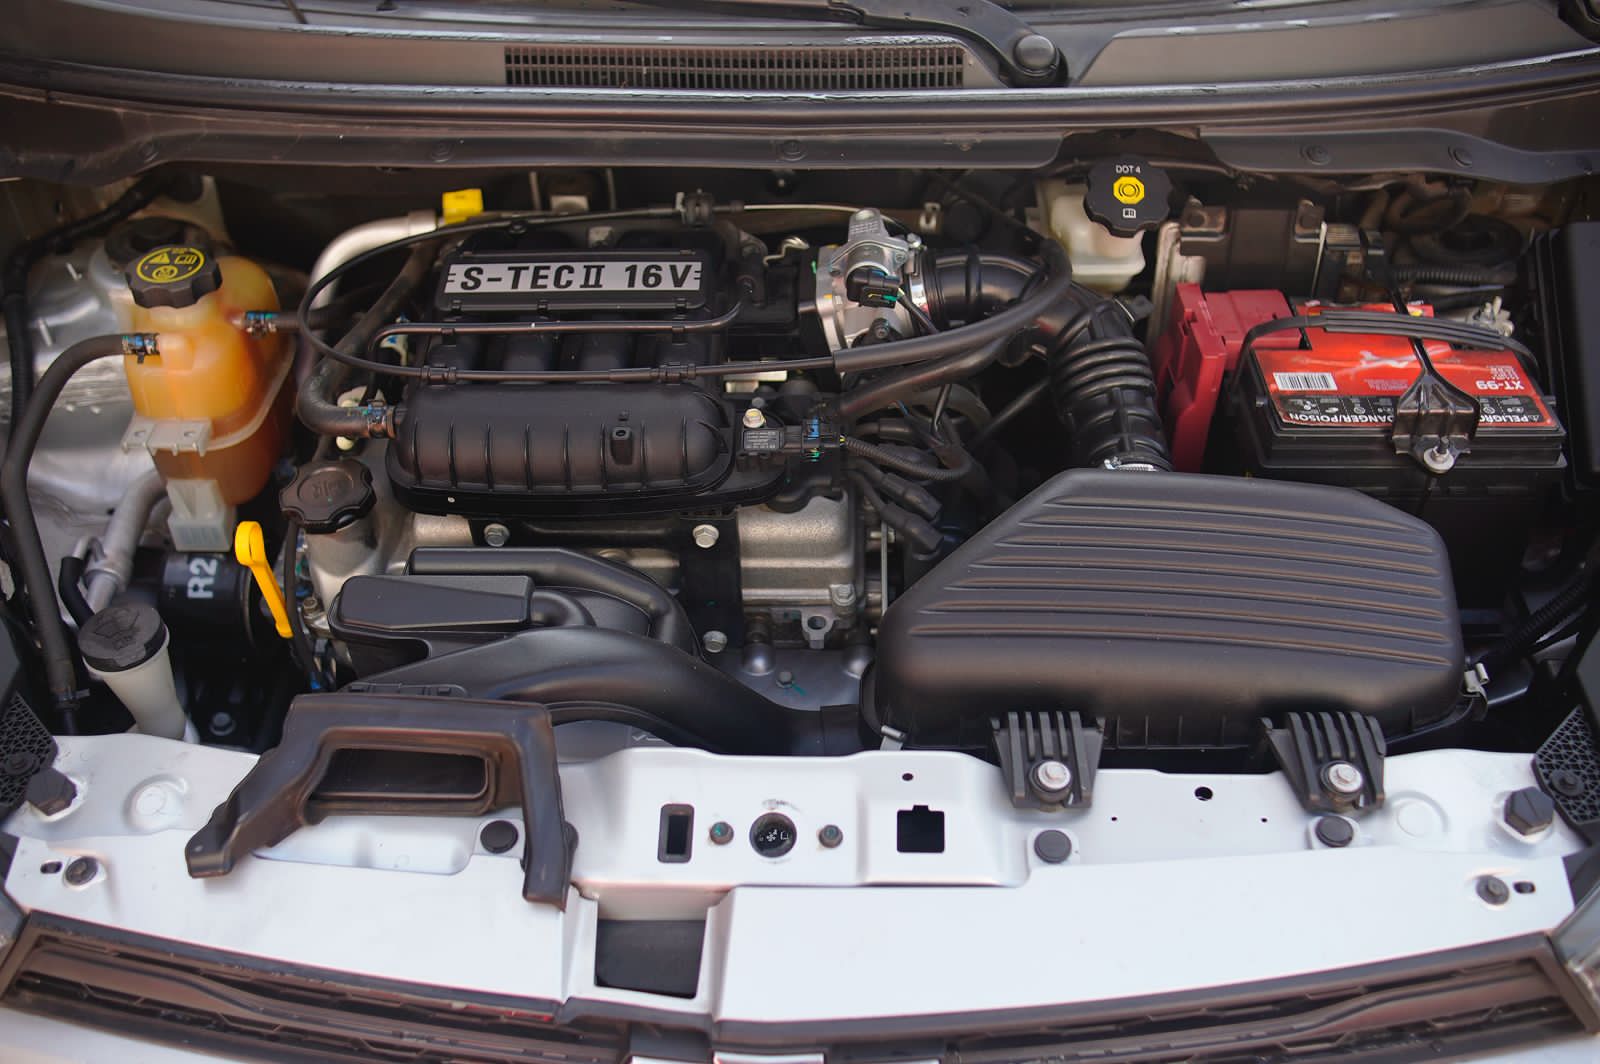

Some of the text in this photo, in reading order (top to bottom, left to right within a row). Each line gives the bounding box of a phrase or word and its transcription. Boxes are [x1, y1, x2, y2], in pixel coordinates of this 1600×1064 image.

[1115, 165, 1142, 174] DOT 4
[625, 264, 693, 289] 16V
[1475, 380, 1525, 390] XT-99
[187, 557, 218, 599] R2
